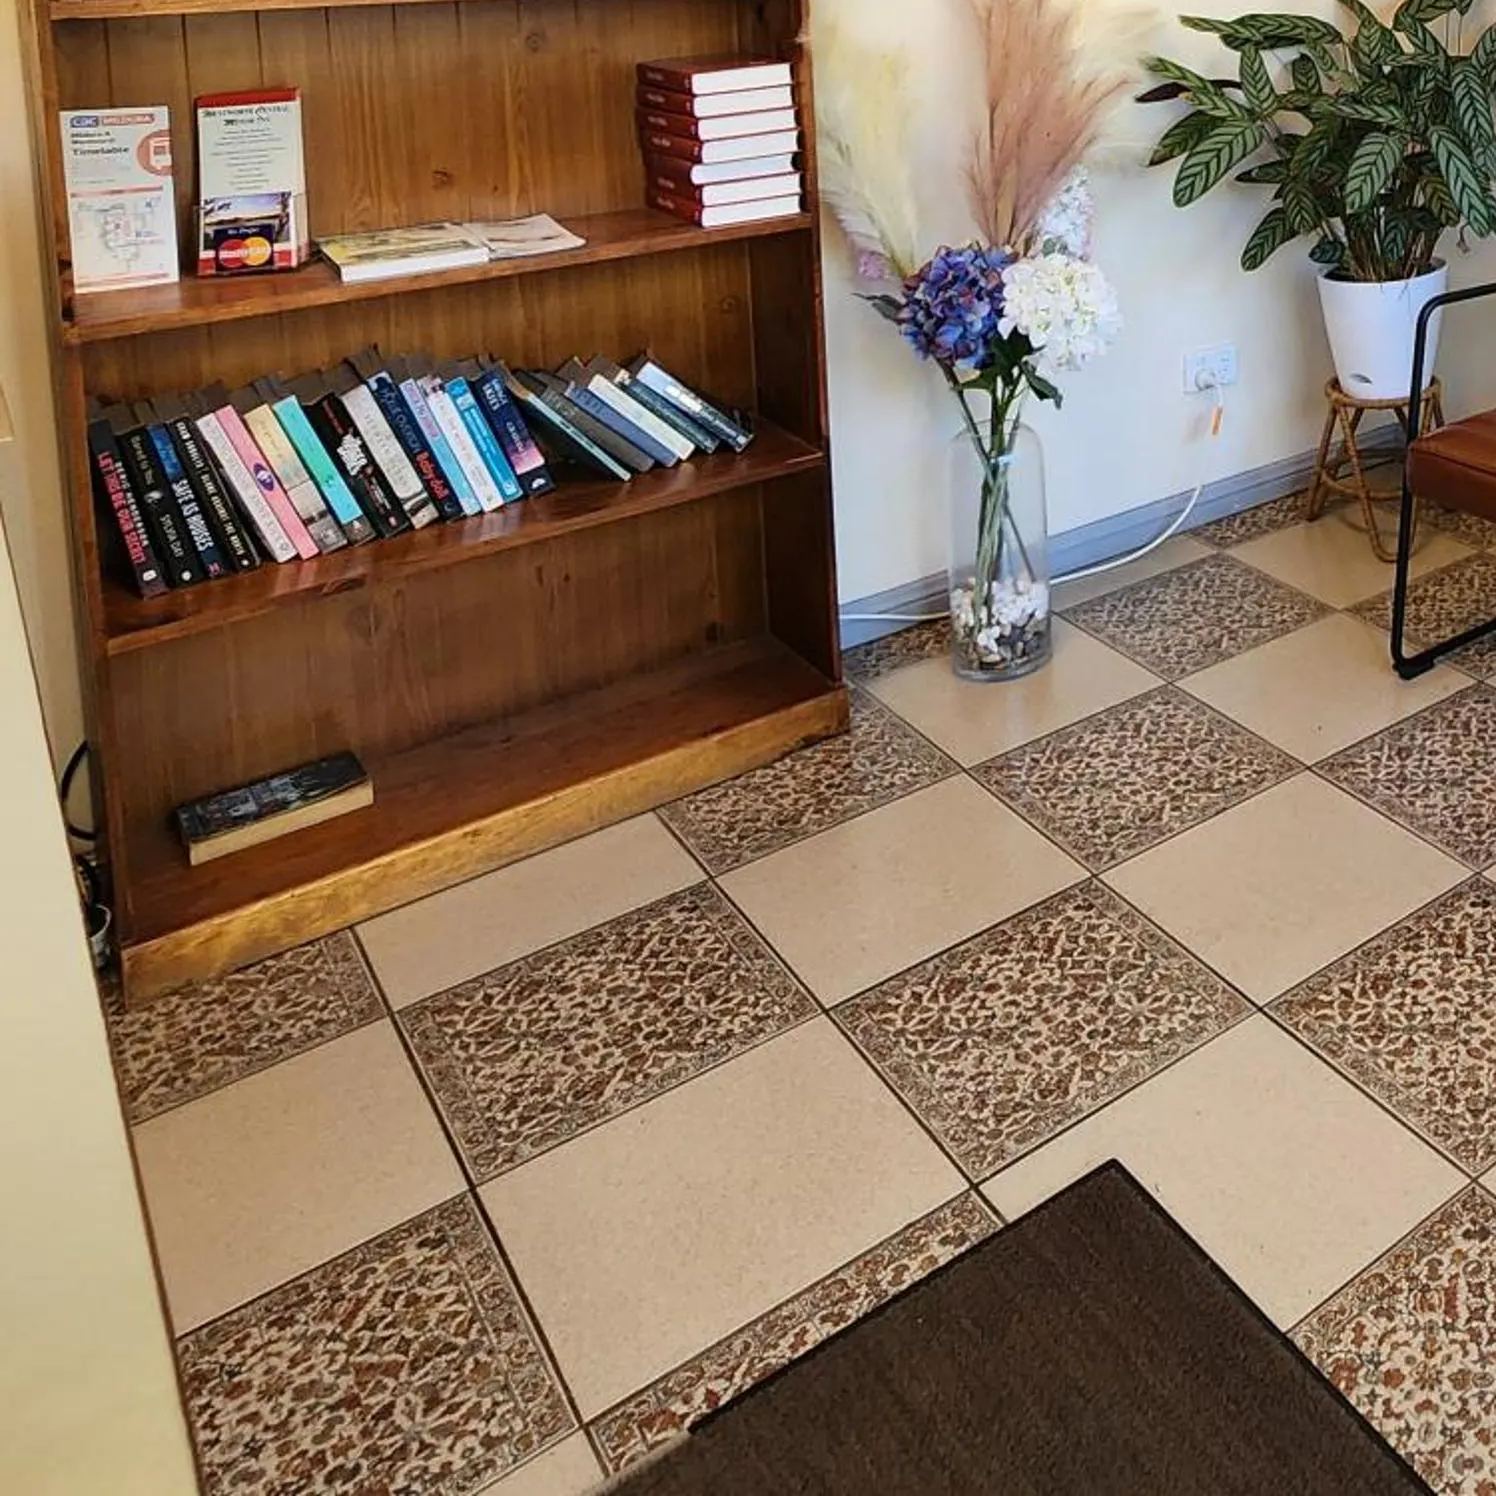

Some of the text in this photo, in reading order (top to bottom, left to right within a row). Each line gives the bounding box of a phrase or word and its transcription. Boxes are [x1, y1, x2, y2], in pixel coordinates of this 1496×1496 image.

[73, 147, 130, 155] Timetable
[171, 479, 194, 502] SAFE
[186, 515, 214, 552] HOUSES
